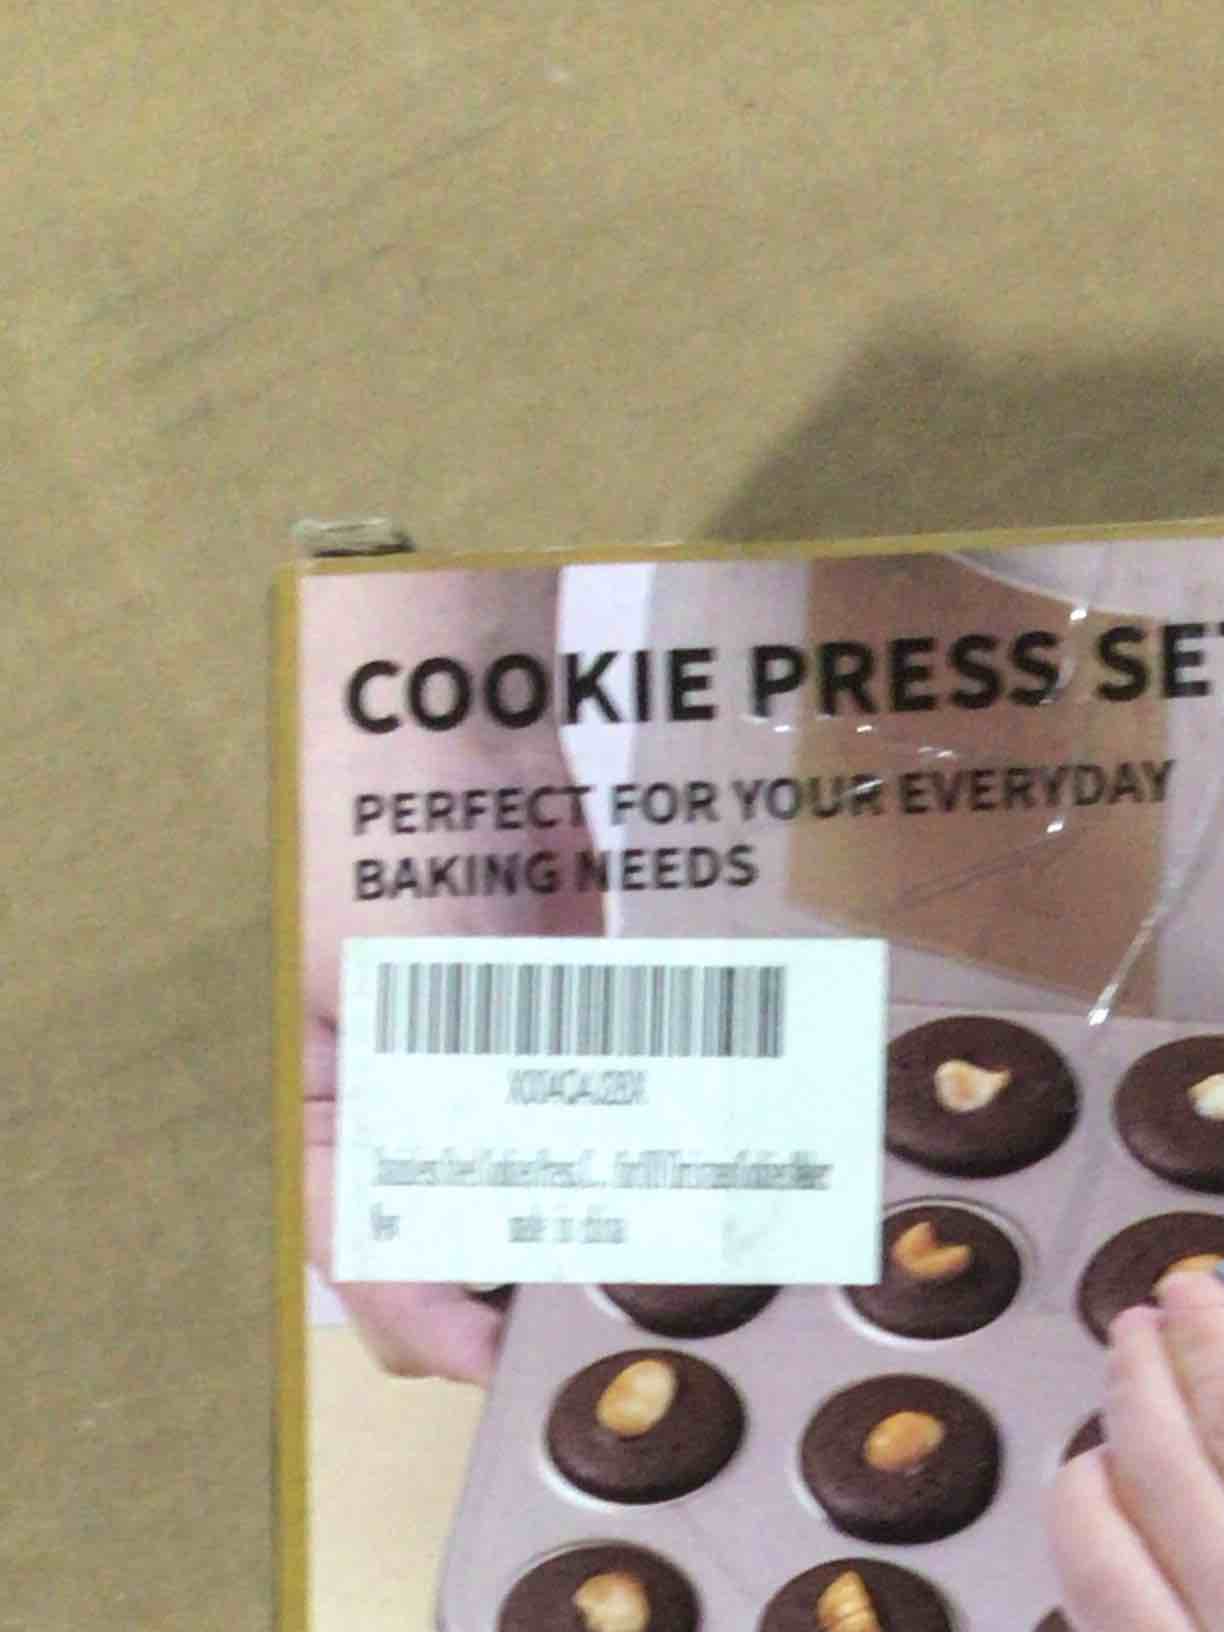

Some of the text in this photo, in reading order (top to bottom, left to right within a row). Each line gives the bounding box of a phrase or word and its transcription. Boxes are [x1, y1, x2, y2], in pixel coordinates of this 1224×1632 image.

[346, 646, 717, 734] COOKIE
[750, 631, 1061, 719] PRESS
[353, 760, 1177, 837] PERFECT FOR YOUR EVERYDAY
[353, 843, 759, 901] BAKING NEEDS
